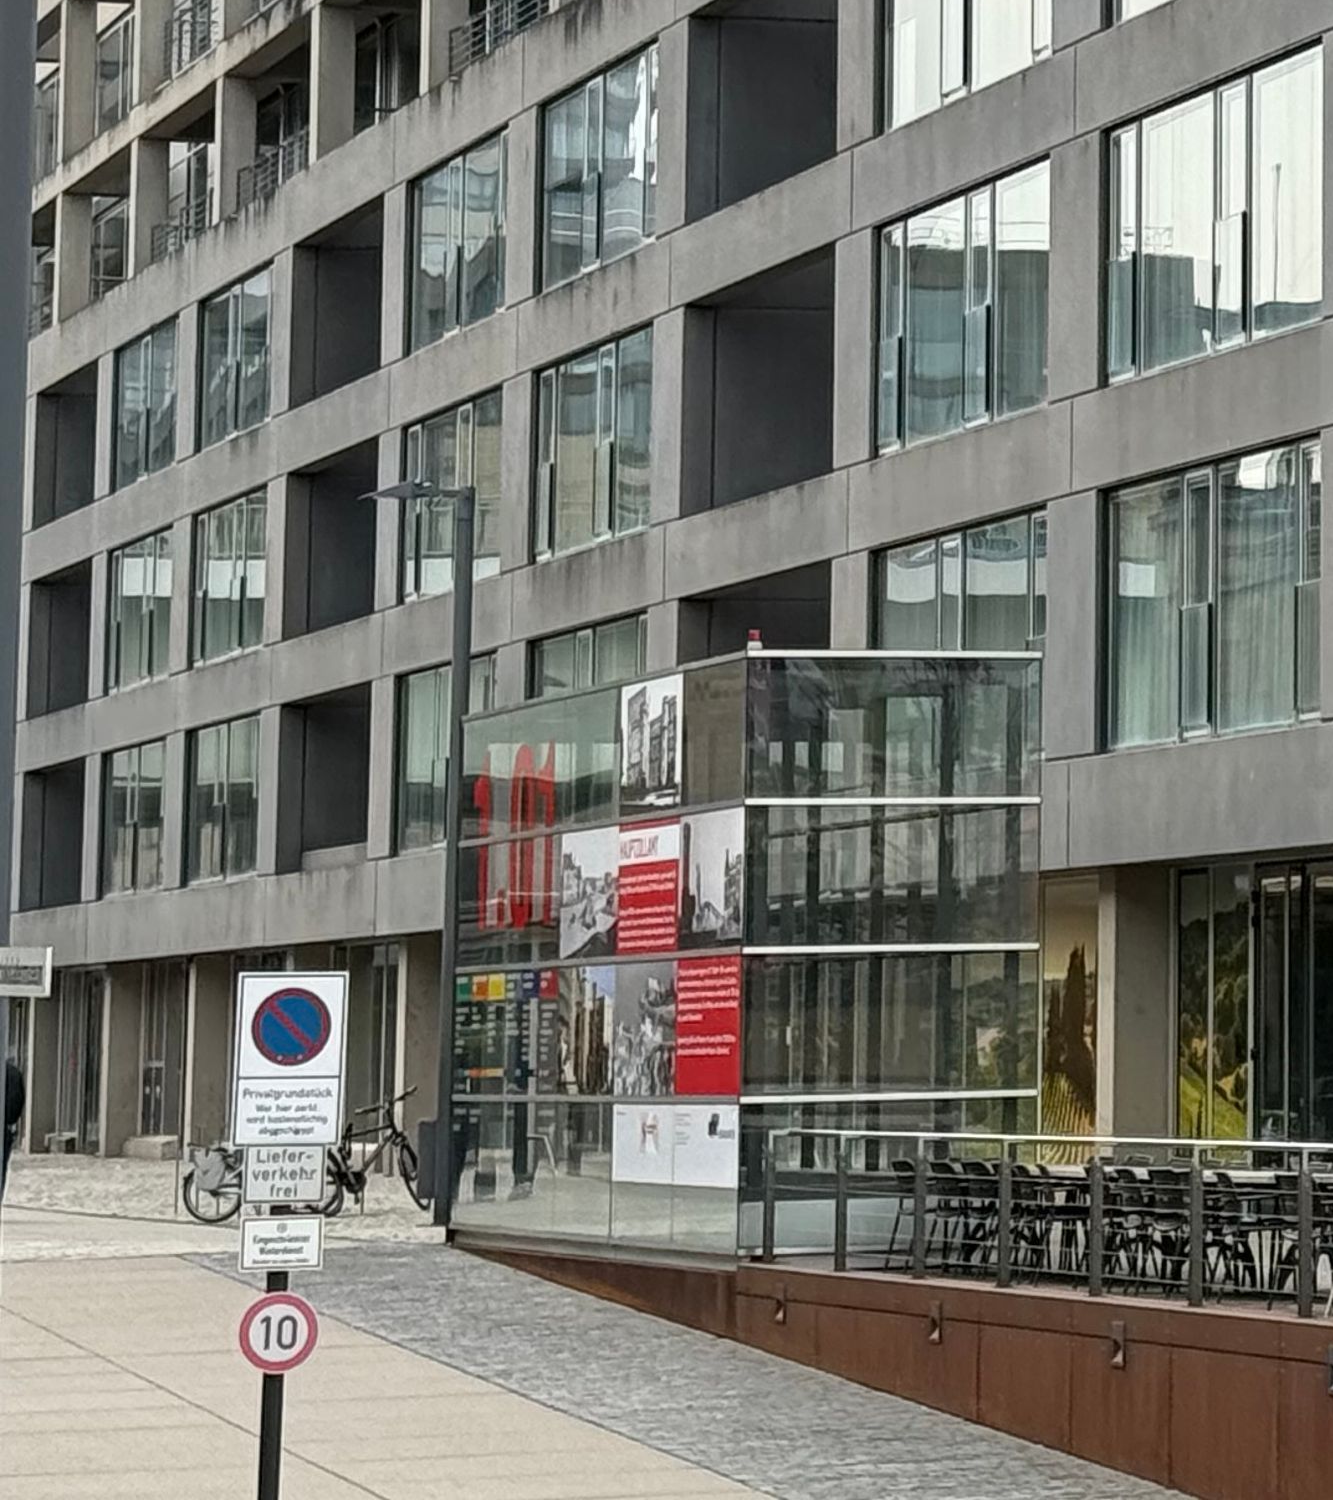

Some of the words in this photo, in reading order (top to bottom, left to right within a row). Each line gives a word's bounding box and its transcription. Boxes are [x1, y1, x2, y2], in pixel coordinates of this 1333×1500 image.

[256, 1149, 314, 1164] Liefer-
[252, 1166, 317, 1182] verkehr
[270, 1184, 298, 1199] frei
[260, 1315, 298, 1351] 10
